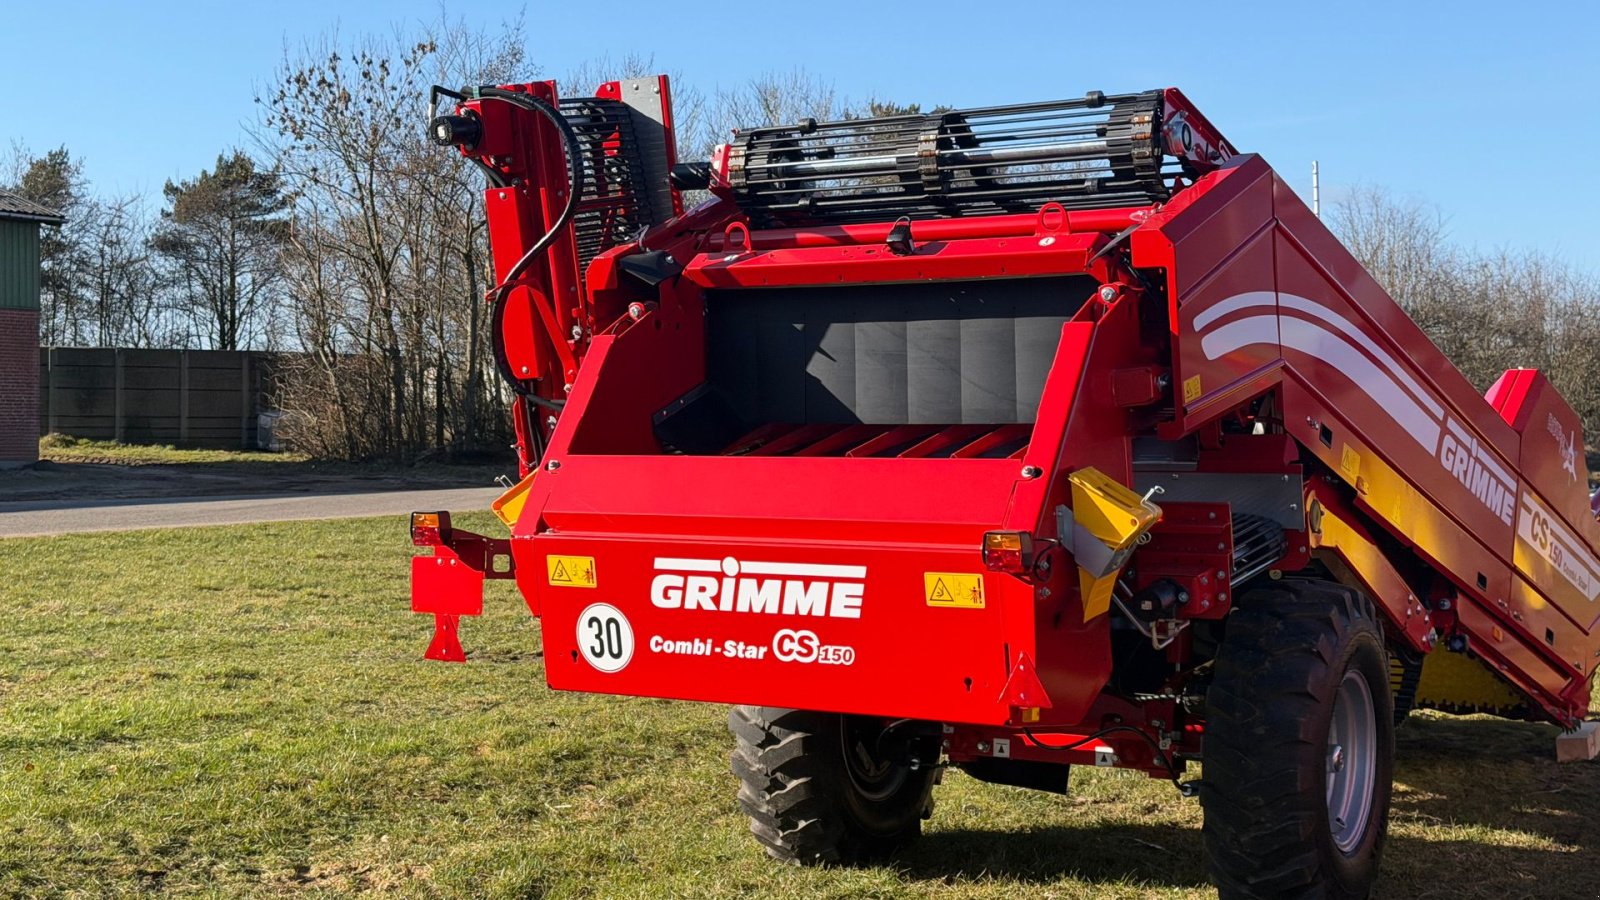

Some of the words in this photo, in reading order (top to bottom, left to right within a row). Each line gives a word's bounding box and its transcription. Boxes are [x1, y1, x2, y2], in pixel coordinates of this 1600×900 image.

[1440, 434, 1516, 527] GRIMME
[1531, 511, 1549, 550] CS
[1549, 542, 1563, 568] 150
[651, 557, 865, 619] GRIMME
[588, 616, 623, 660] 30
[773, 628, 820, 663] CS
[818, 645, 855, 665] 150
